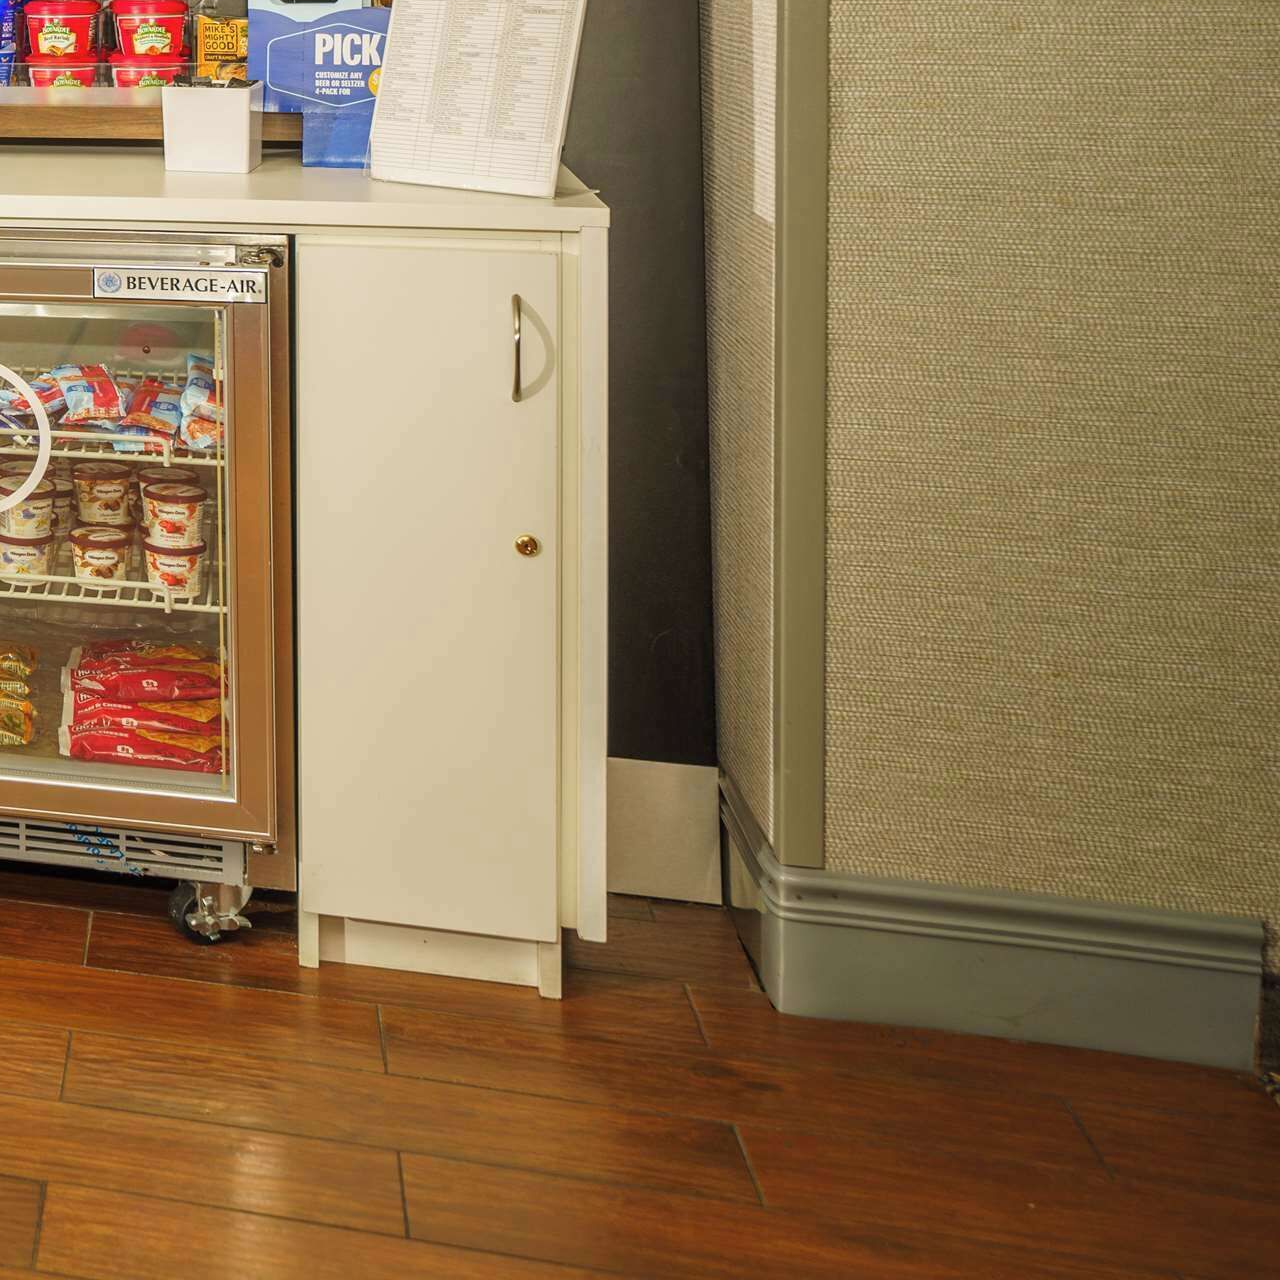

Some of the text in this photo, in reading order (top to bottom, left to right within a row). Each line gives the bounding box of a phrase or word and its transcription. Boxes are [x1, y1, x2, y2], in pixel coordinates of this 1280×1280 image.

[204, 24, 236, 34] MIKE'S
[204, 33, 236, 43] MIGHTY
[205, 41, 235, 51] GOOD
[314, 33, 382, 66] PICK
[314, 71, 363, 80] CUSTOMIZE ANY
[314, 79, 366, 88] BEER OR SELTZER
[314, 87, 351, 96] 4-PACK FOR
[126, 276, 256, 294] BEVERAGE-AIR
